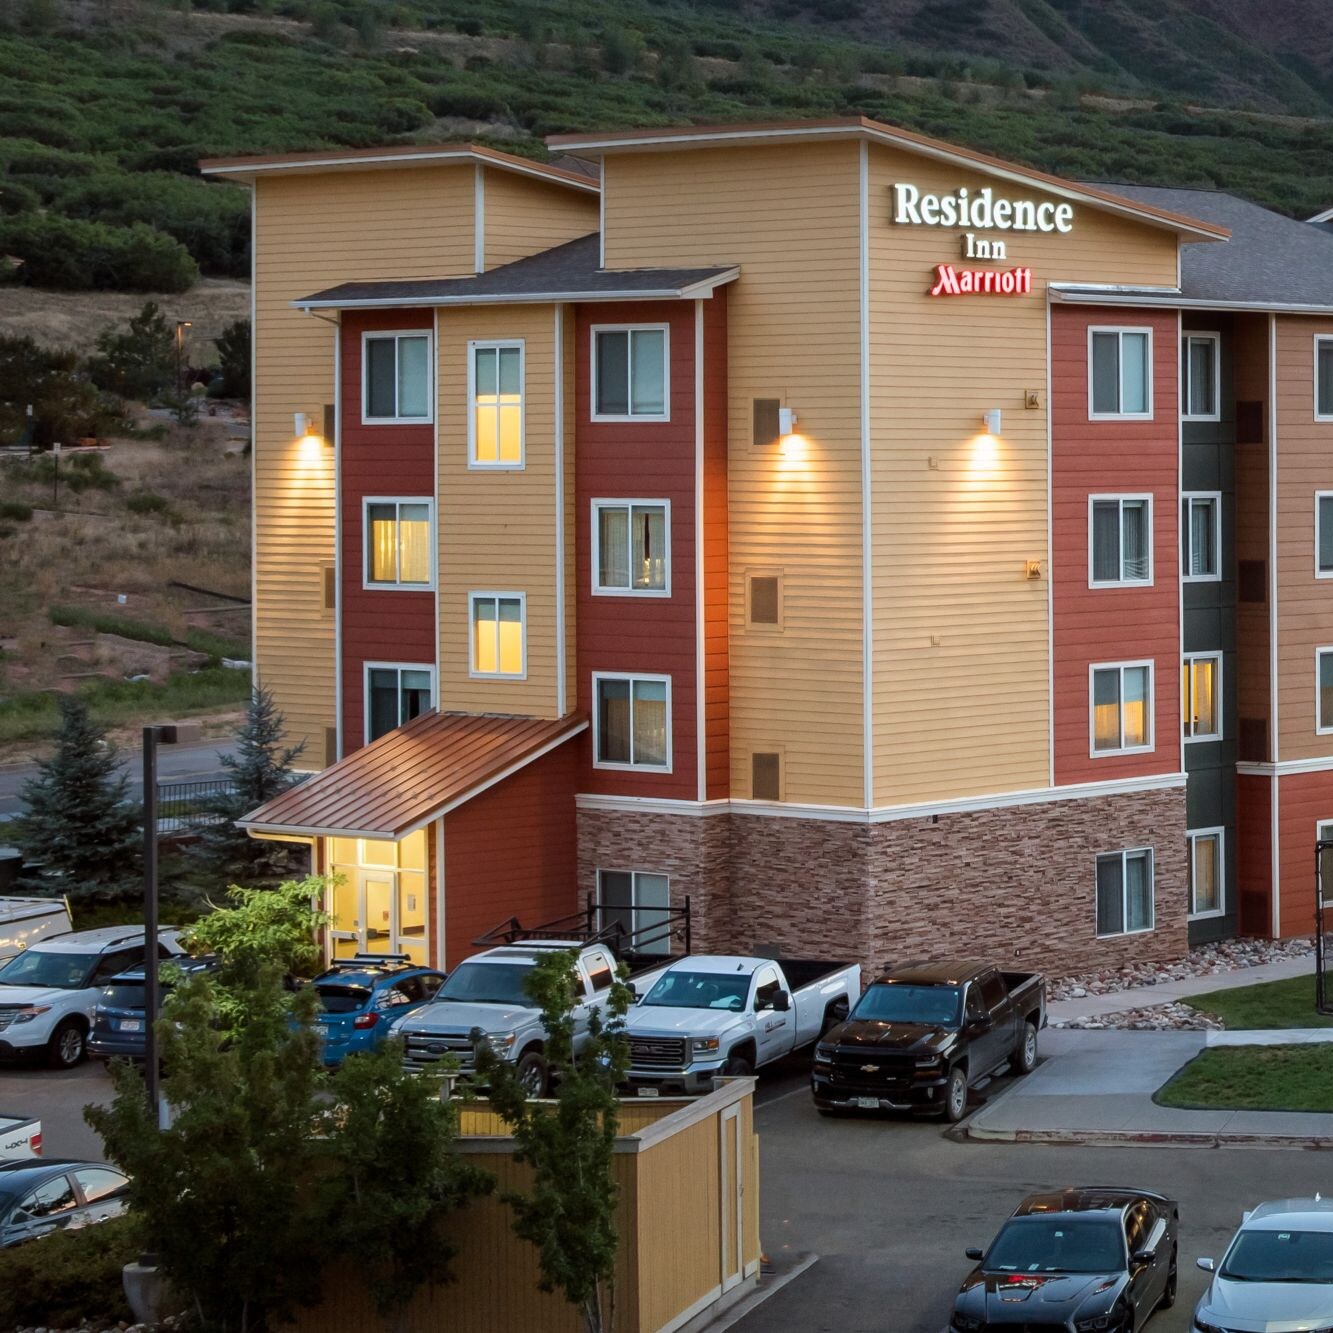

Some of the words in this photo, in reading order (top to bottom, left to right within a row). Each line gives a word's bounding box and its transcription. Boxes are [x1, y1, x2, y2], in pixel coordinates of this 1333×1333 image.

[894, 183, 1073, 232] Residence
[966, 233, 1007, 260] Inn
[930, 264, 1032, 296] Marriott
